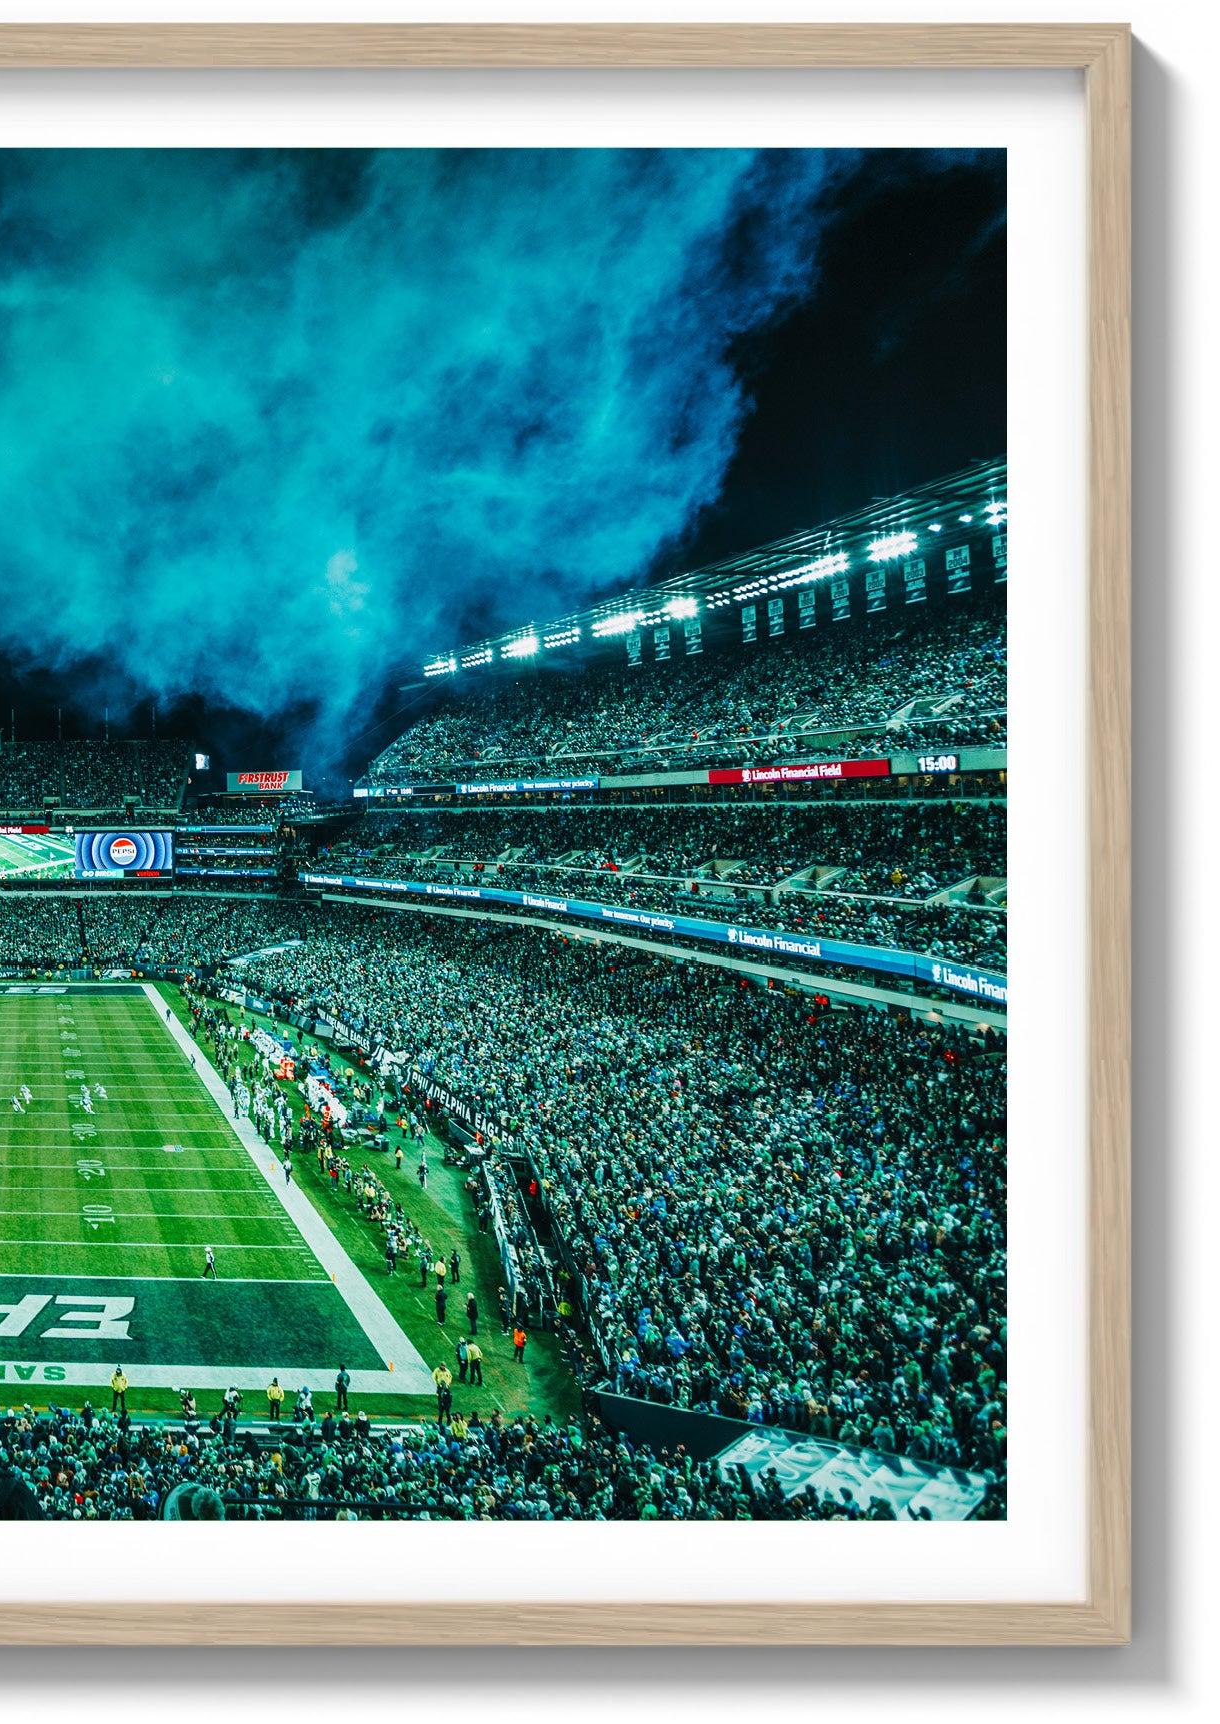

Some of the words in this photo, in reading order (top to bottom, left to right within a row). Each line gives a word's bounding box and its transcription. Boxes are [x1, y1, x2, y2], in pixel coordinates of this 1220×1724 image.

[948, 556, 968, 568] 2004
[906, 568, 924, 580] 2003
[867, 579, 885, 590] 2002
[918, 755, 956, 772] 15:00
[752, 769, 781, 781] Lincoln
[781, 765, 819, 779] Financial
[819, 764, 842, 776] Field
[259, 782, 283, 790] BANK
[468, 783, 489, 793] Lincoln
[489, 782, 517, 792] Financial
[571, 780, 594, 789] priority.
[309, 875, 324, 883] Lincoln
[324, 876, 342, 885] Financial
[433, 886, 453, 895] Lincoln
[453, 888, 481, 898] Financial
[528, 896, 545, 908] Lincoln
[545, 899, 567, 912] Financial
[640, 914, 651, 924] Our
[738, 930, 773, 949] Lincoln
[773, 935, 821, 957] Financial
[943, 967, 978, 993] Lincoln
[350, 1030, 371, 1052] EAGLES
[71, 1123, 97, 1136] 30
[76, 1159, 105, 1176] 20
[82, 1204, 115, 1224] 10
